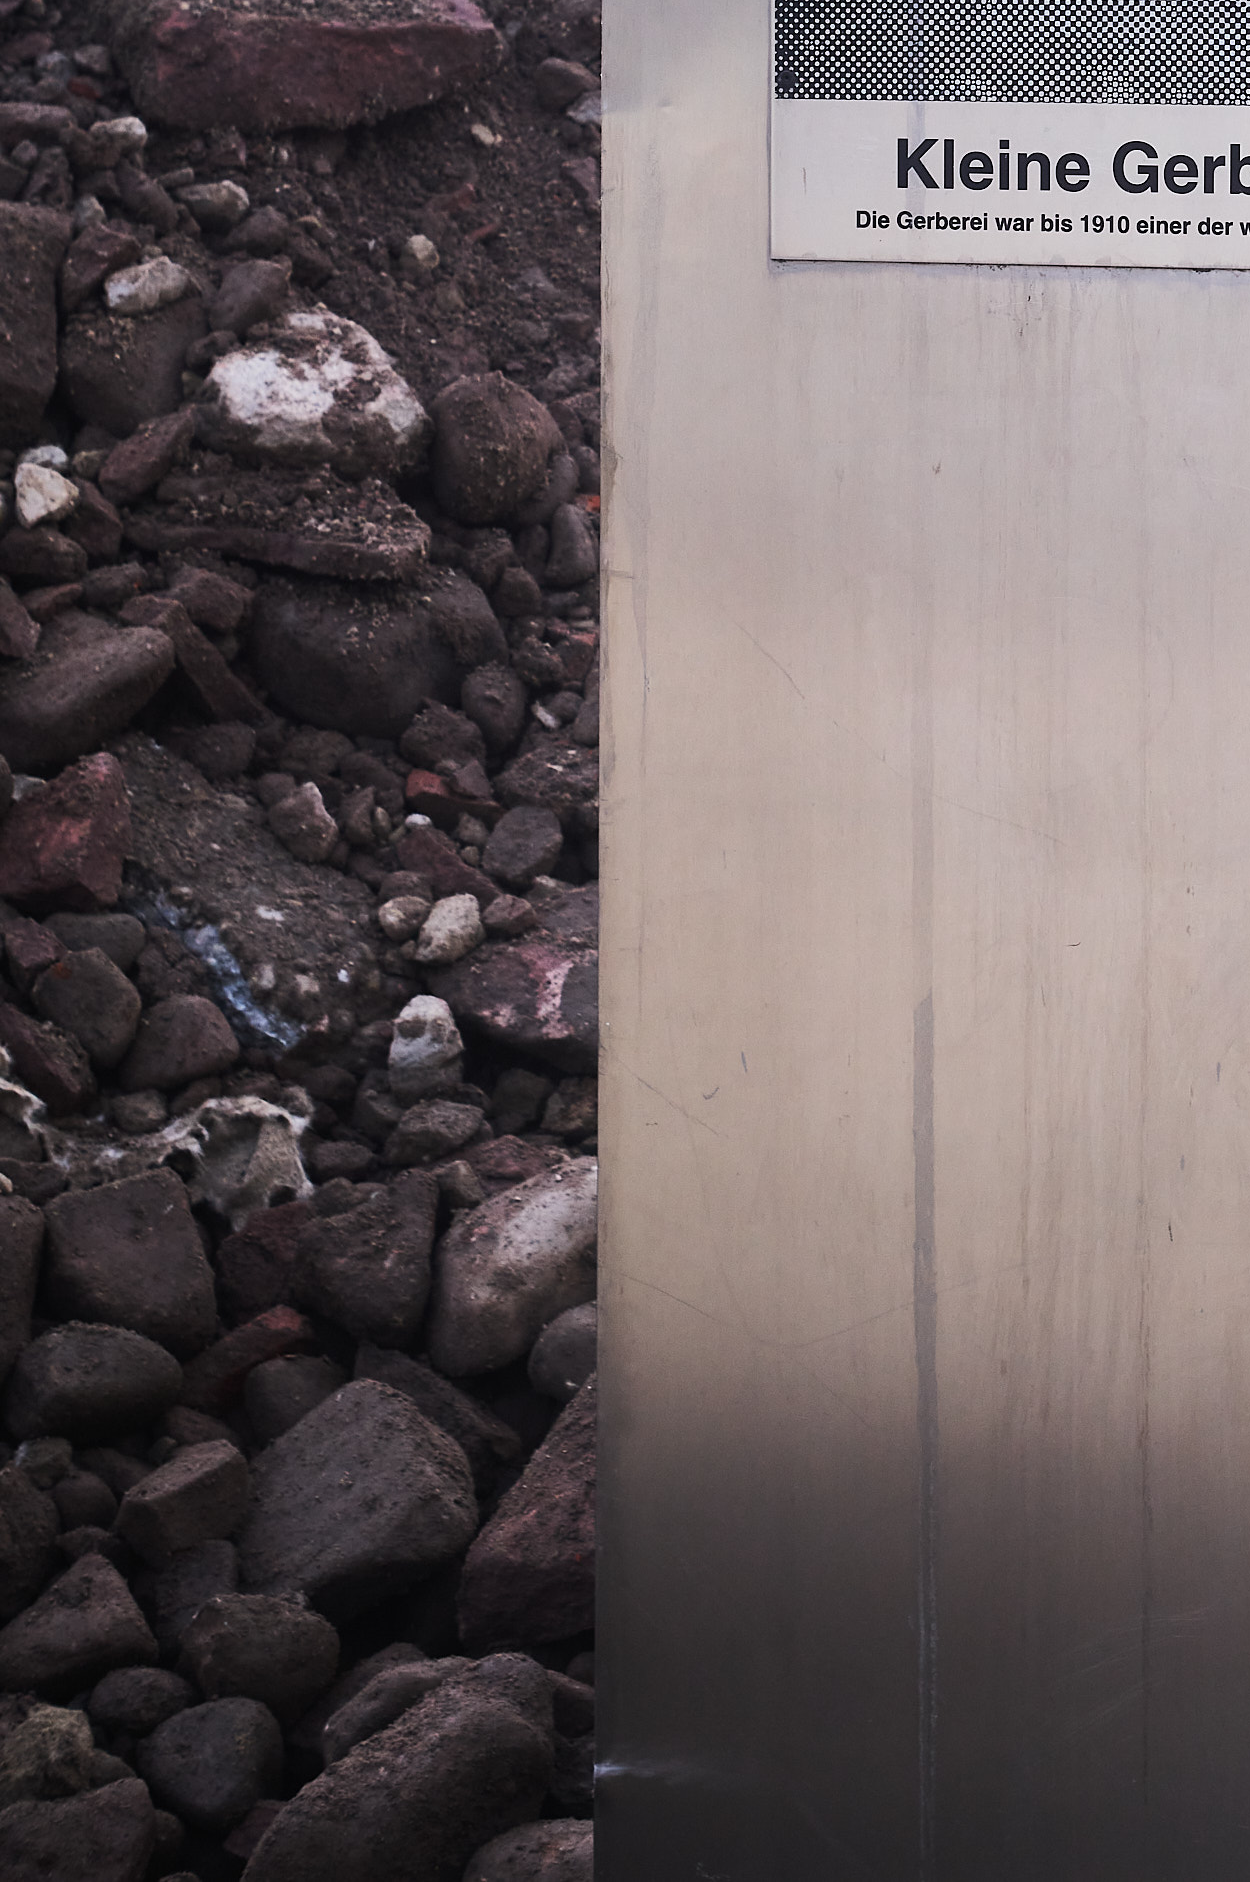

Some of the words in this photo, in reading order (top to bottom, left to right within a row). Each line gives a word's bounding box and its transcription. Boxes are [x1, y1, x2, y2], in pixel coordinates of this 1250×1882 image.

[897, 138, 1091, 193] Kleine
[856, 210, 890, 229] Die
[896, 210, 988, 231] Gerberei
[994, 217, 1035, 232] war
[1040, 213, 1073, 233] bis
[1080, 214, 1130, 234] 1910
[1136, 215, 1192, 235] einer
[1197, 216, 1234, 236] der
